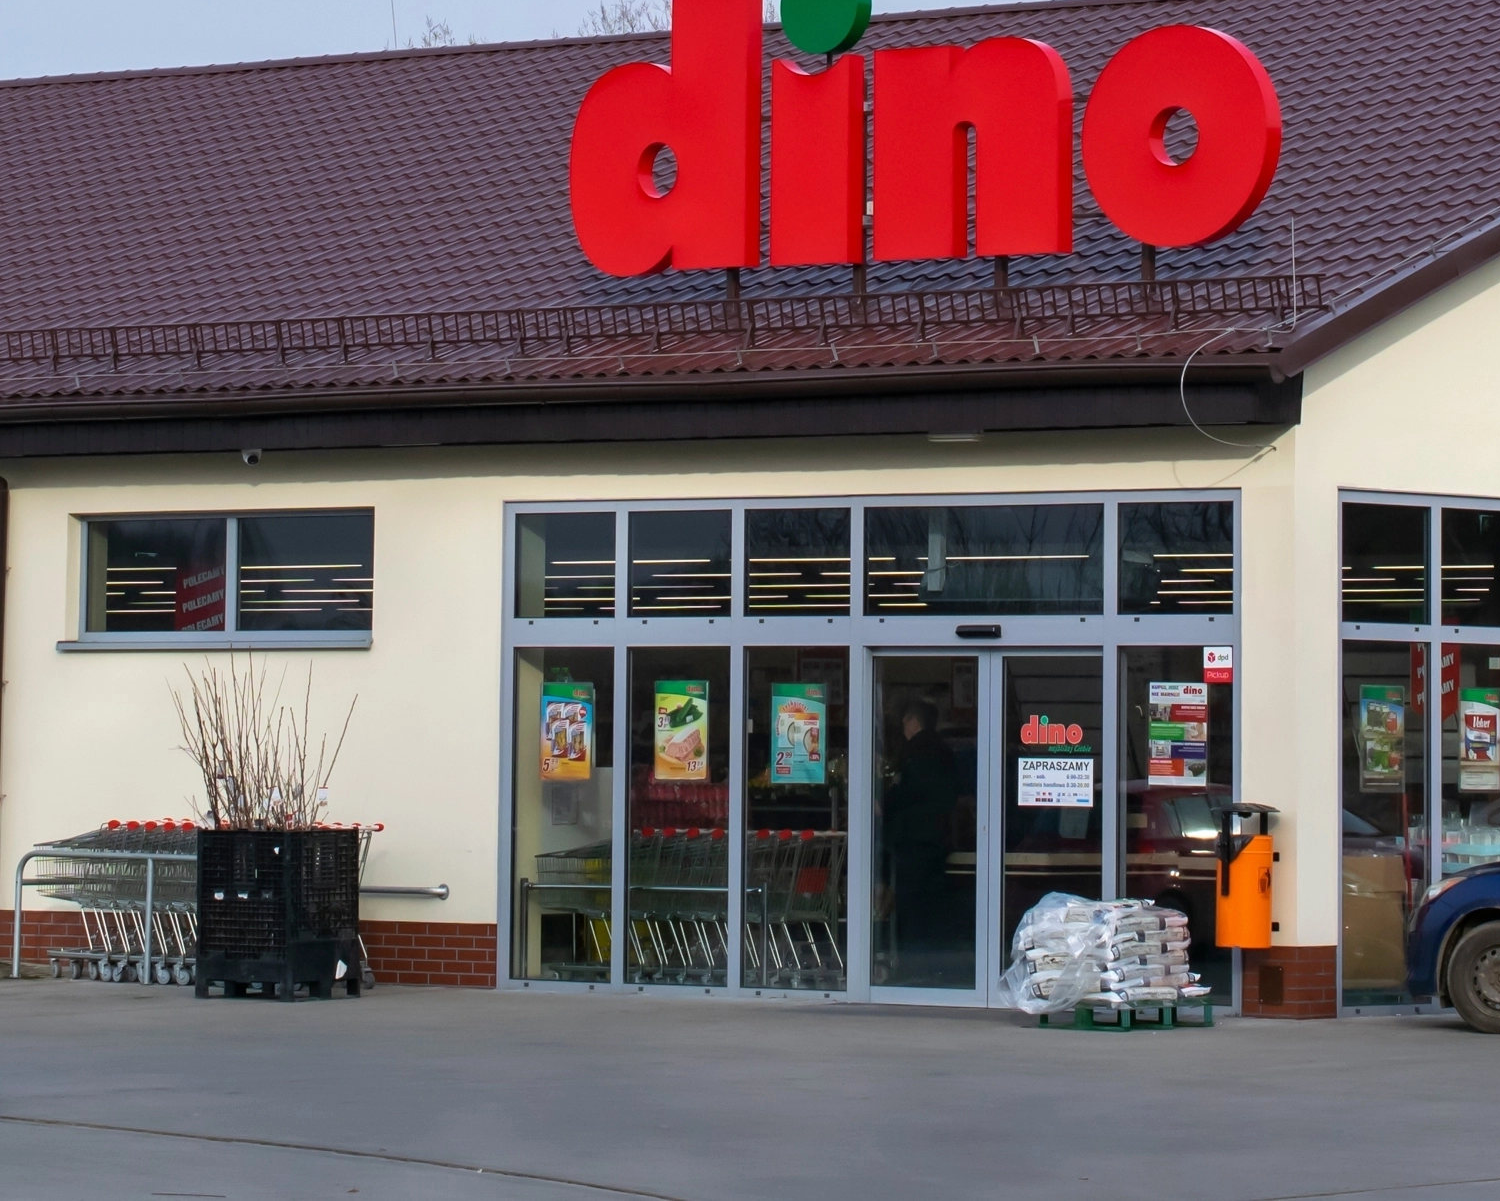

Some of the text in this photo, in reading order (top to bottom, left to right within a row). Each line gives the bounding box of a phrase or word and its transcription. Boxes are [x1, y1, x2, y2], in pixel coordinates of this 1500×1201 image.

[183, 564, 225, 589] POLECAMY
[182, 589, 224, 613] POLECAMY
[1217, 654, 1229, 662] dpd
[1206, 671, 1230, 679] Pickup
[1183, 685, 1203, 695] dino
[1020, 715, 1083, 744] dino
[1022, 761, 1090, 771] ZAPRASZAMY
